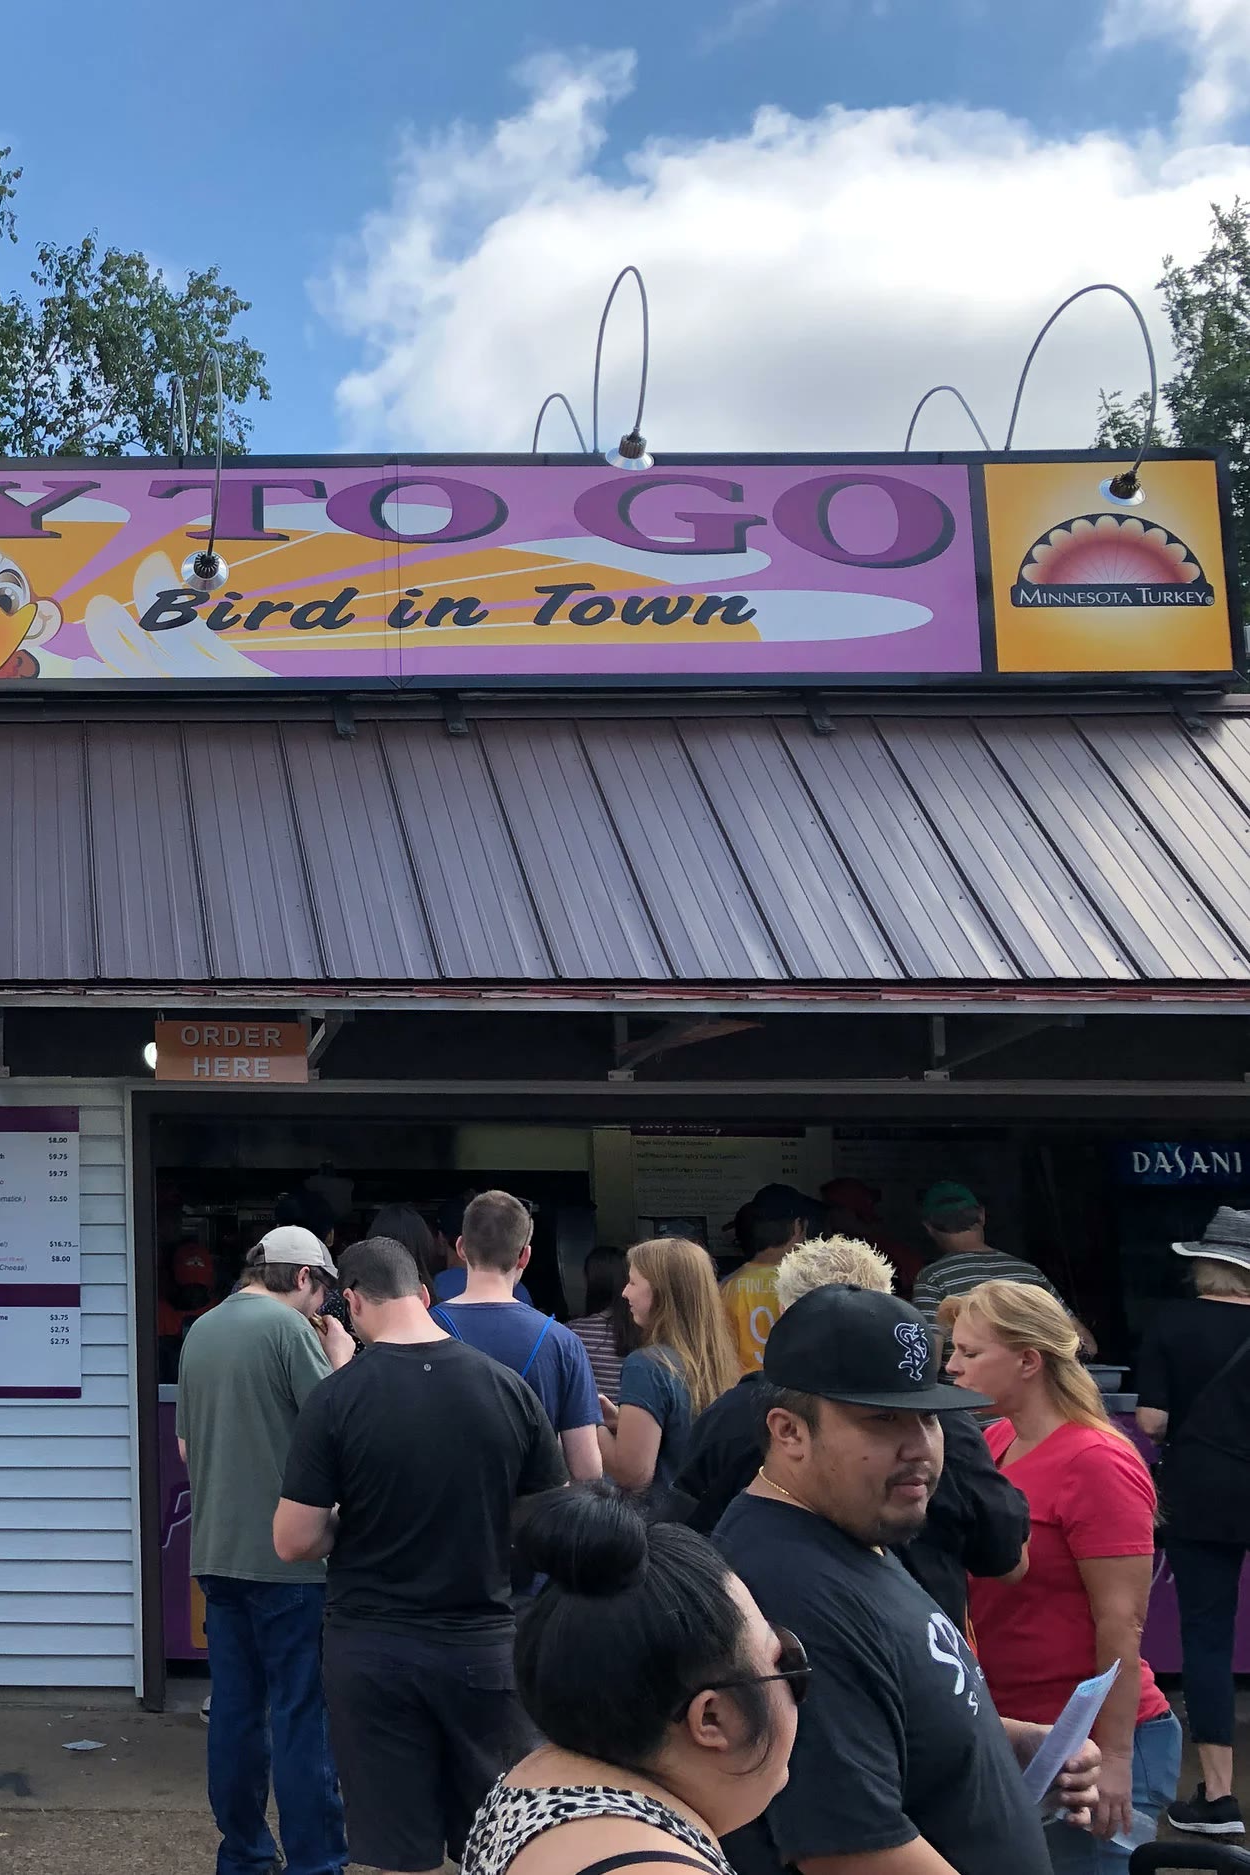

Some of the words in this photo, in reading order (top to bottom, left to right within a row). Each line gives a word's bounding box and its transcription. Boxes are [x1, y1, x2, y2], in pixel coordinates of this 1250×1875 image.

[150, 473, 509, 543] TO
[574, 472, 956, 569] GO
[140, 587, 362, 632] Bird
[385, 588, 488, 628] in
[531, 583, 759, 629] Town
[180, 1025, 282, 1047] ORDER
[194, 1056, 270, 1078] HERE
[1132, 1144, 1242, 1179] DASANI
